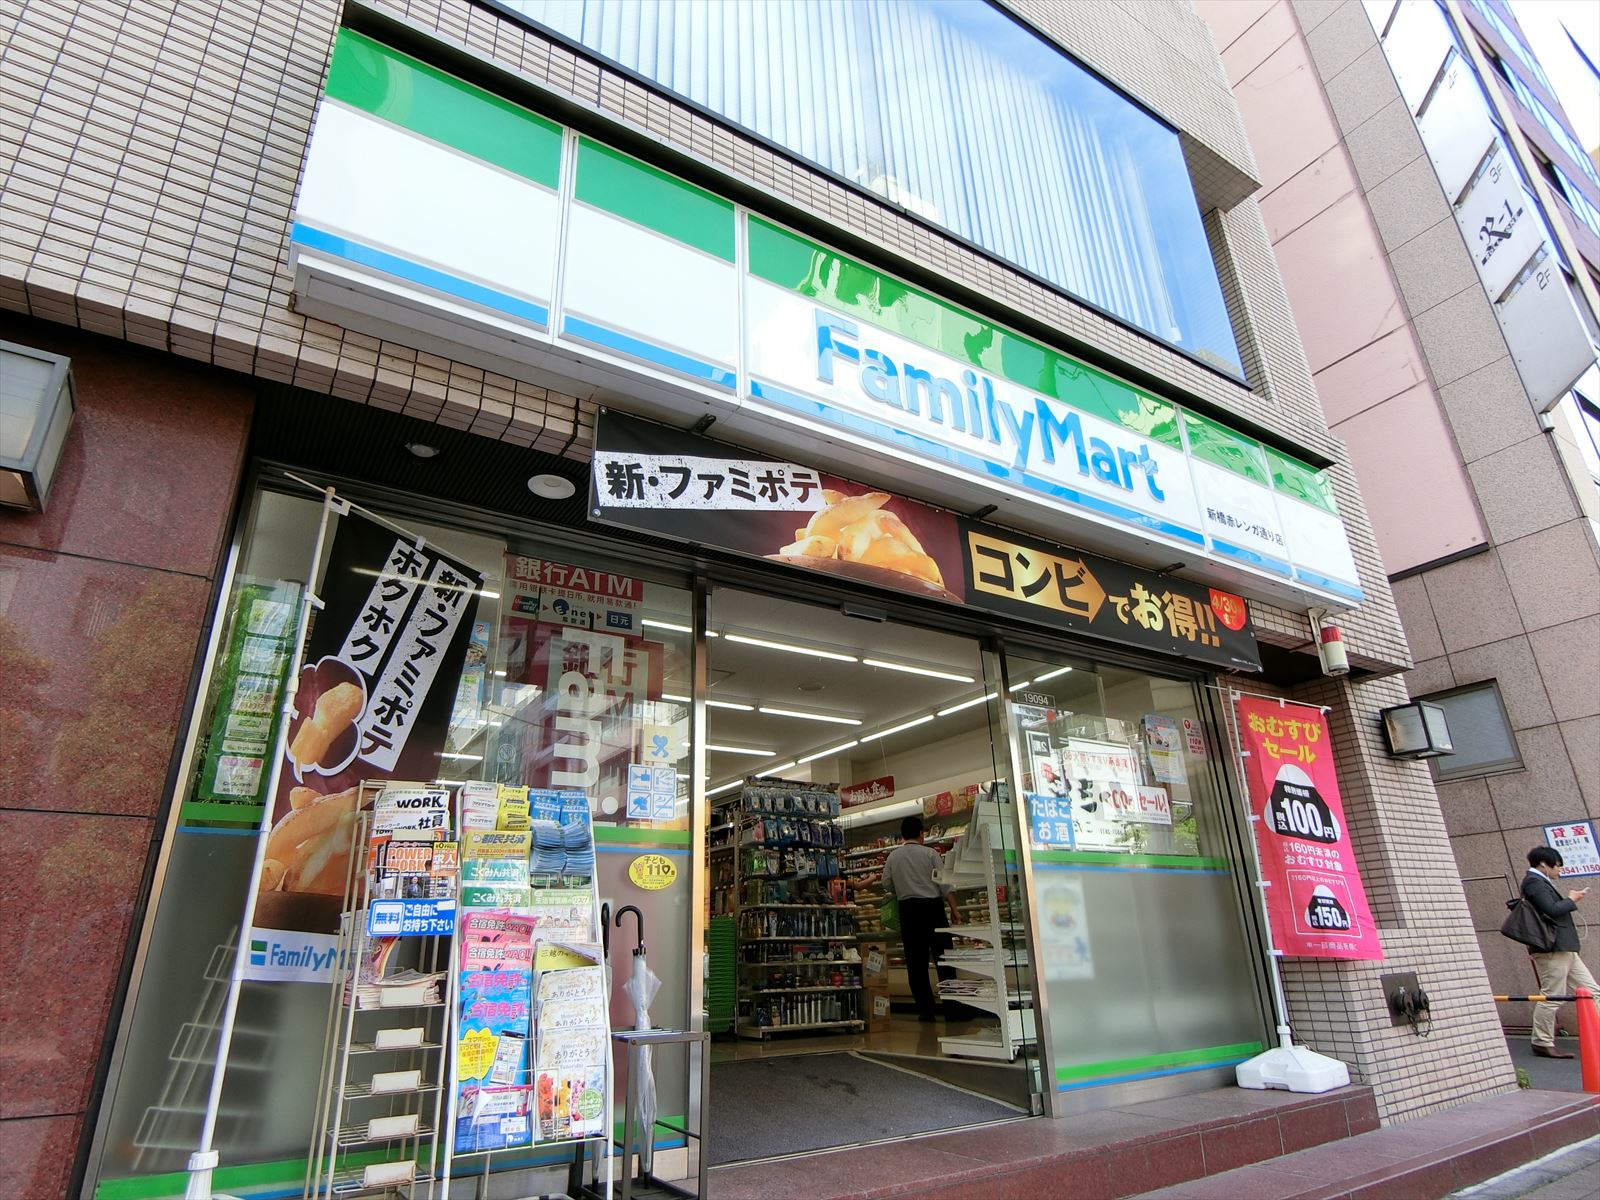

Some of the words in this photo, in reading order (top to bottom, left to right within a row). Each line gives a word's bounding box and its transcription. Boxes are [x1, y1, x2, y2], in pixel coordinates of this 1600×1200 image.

[1489, 163, 1505, 185] 3F
[1535, 268, 1552, 291] 2F
[815, 307, 1165, 502] FamilyMart
[605, 461, 819, 504] 新・ファミポテ
[1206, 507, 1284, 546] 新橋赤レンガ通り店
[515, 556, 633, 598] 銀行ATM
[351, 548, 422, 662] ホクホク
[610, 614, 630, 626] 日元
[360, 570, 468, 755] 新・ファミポテ
[1023, 692, 1050, 706] 19094
[1247, 712, 1321, 743] おむすび
[1262, 738, 1317, 764] セール
[1031, 798, 1071, 818] たばこ
[418, 814, 443, 830] 社員
[1038, 821, 1070, 843] お酒
[375, 911, 400, 925] 無料
[404, 903, 439, 917] ご自由に
[403, 918, 454, 932] お持ち下さい
[552, 988, 587, 999] ありがとう
[554, 1049, 591, 1060] ありがとう
